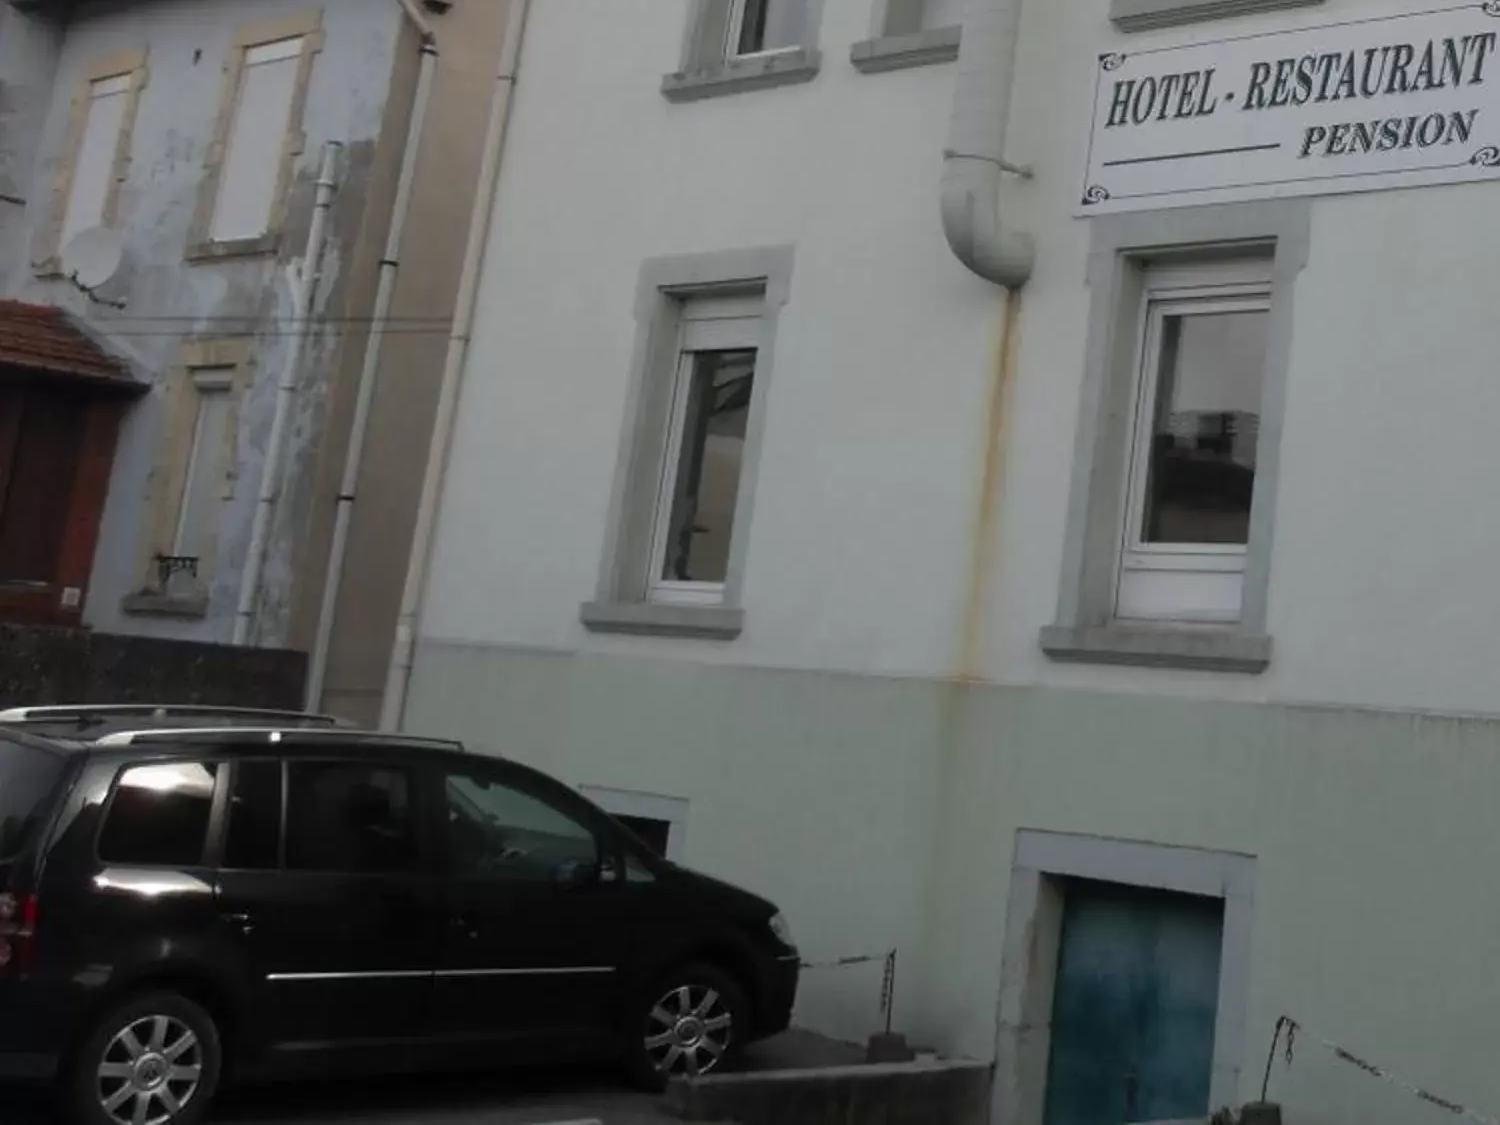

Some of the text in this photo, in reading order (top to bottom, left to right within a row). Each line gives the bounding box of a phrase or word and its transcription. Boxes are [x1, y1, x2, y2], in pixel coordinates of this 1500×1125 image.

[1105, 69, 1216, 127] HOTEL
[1242, 32, 1496, 111] RESTAURANT
[1299, 110, 1478, 158] PENSION
